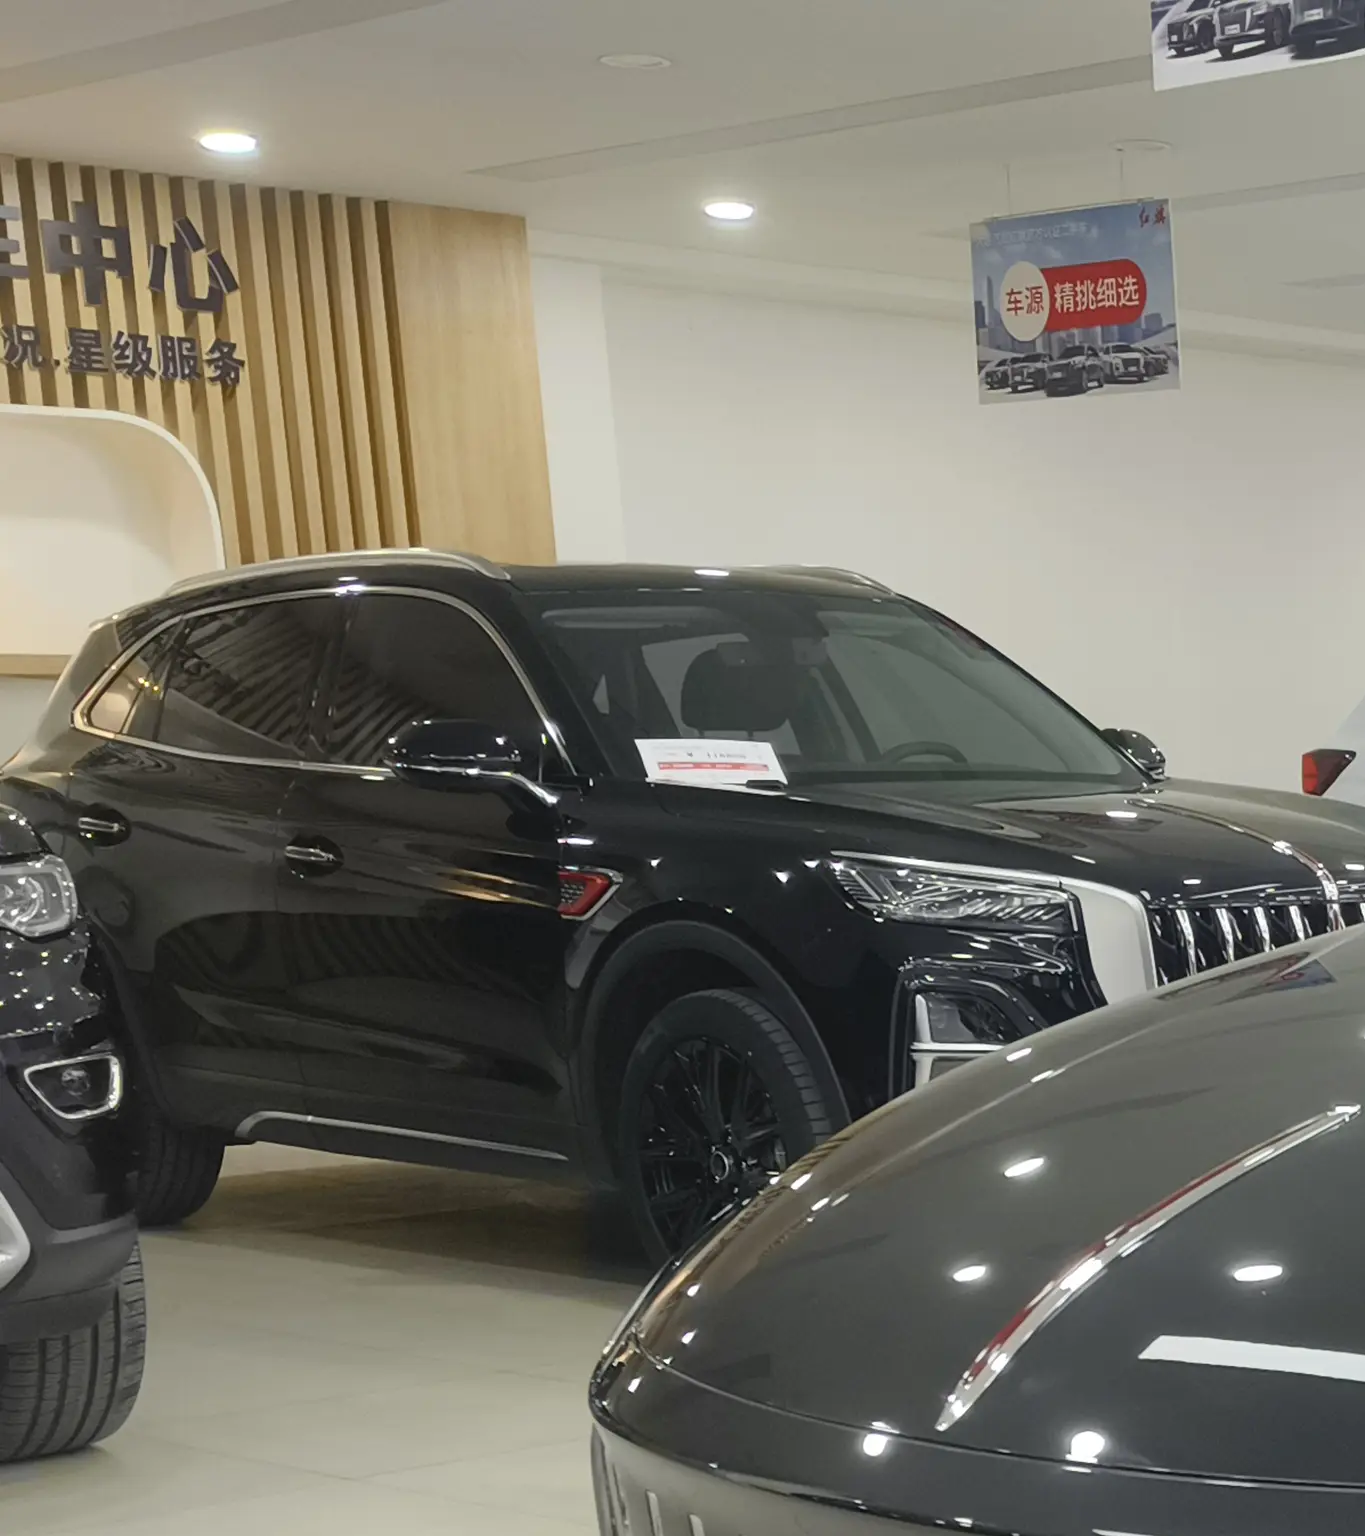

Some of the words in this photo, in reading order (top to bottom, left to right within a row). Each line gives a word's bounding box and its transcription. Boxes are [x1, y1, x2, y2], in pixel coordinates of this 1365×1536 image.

[1005, 285, 1045, 316] 车源
[1054, 275, 1140, 313] 精挑细选
